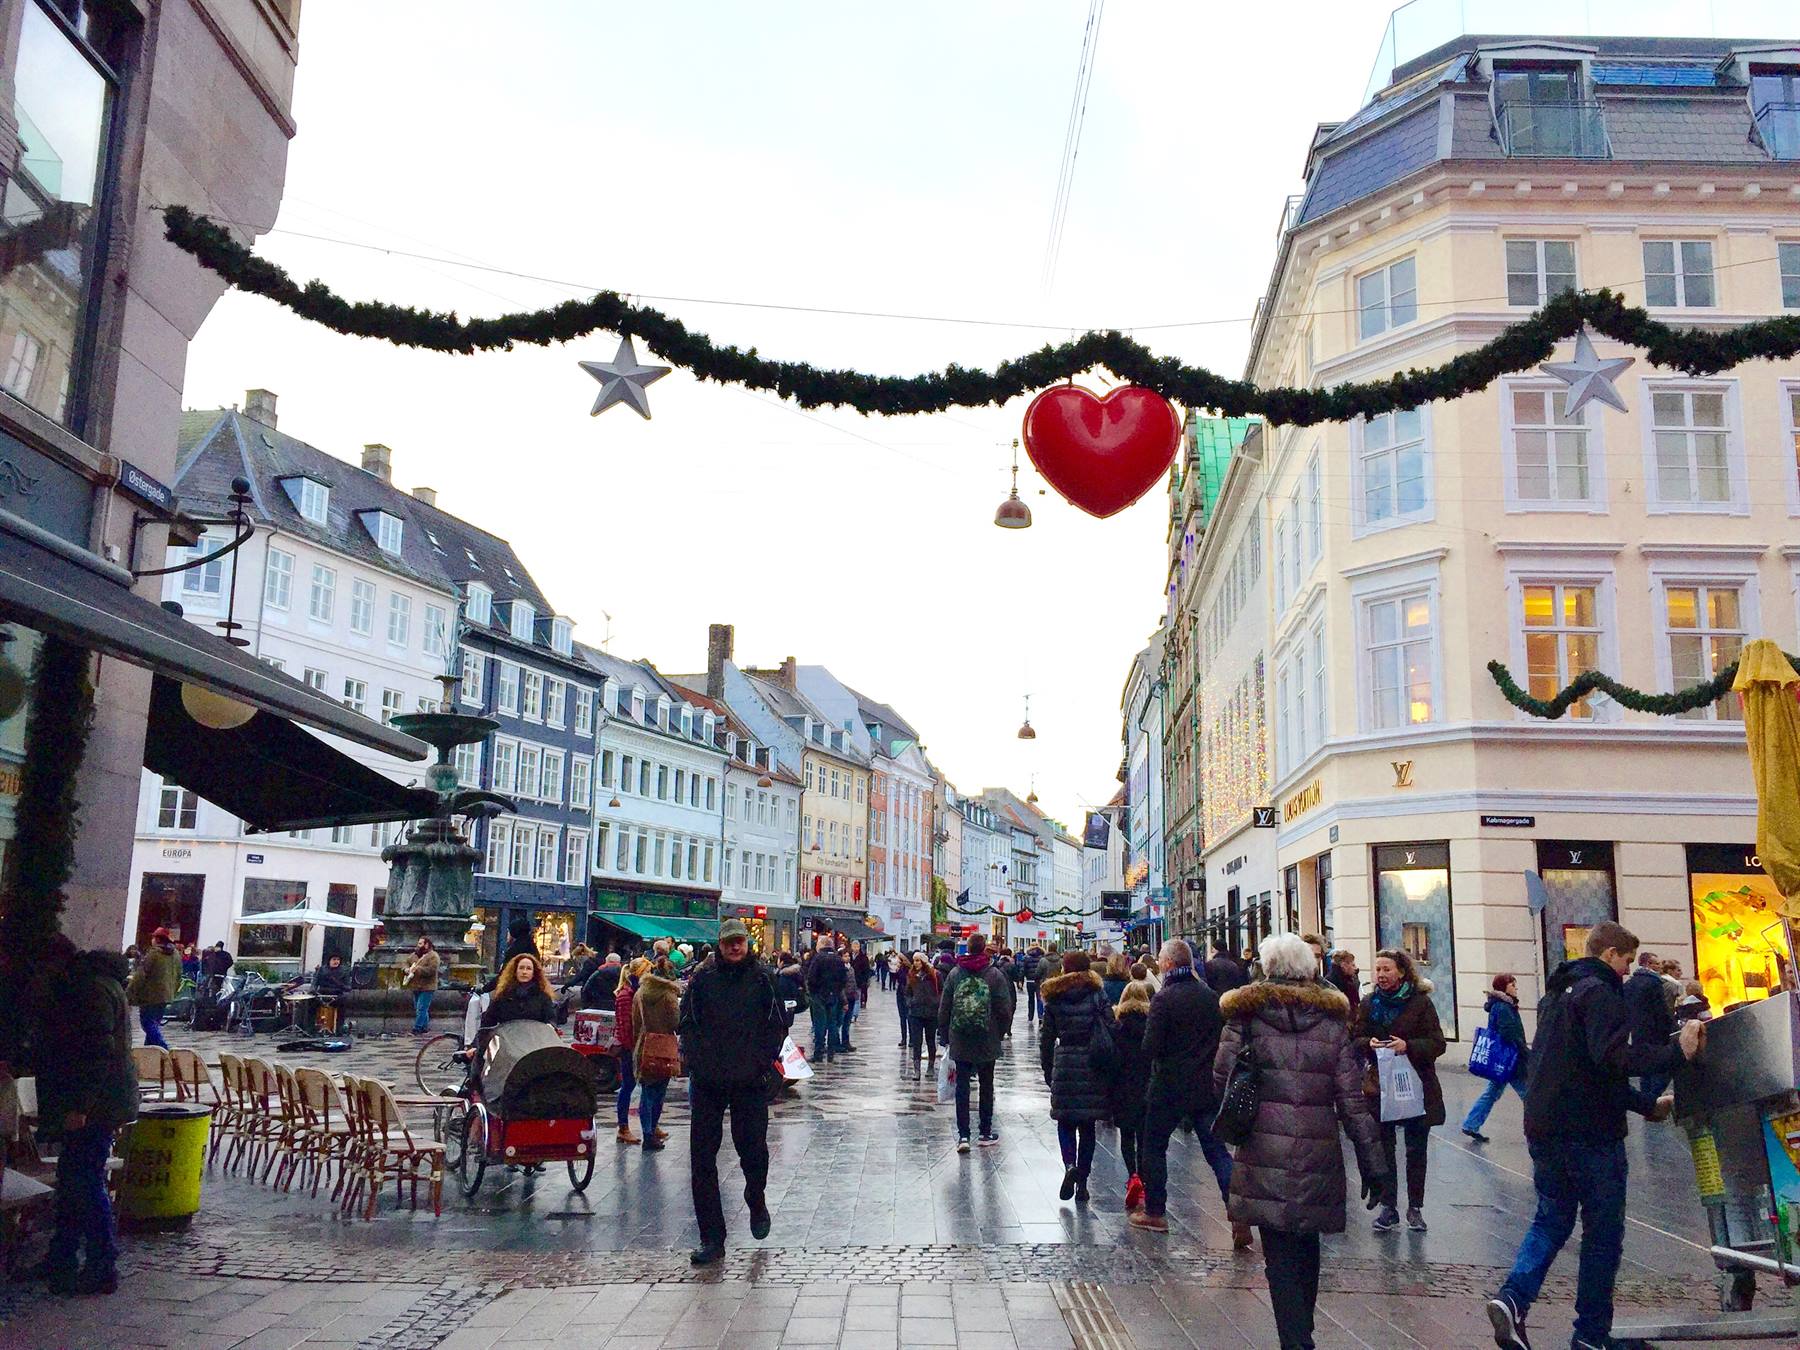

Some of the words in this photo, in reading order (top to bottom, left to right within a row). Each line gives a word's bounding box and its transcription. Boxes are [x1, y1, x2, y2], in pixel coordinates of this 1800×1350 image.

[129, 470, 165, 502] Østergade
[162, 849, 192, 857] EUROPA
[1477, 1035, 1496, 1049] MY
[1471, 1053, 1488, 1065] BAG
